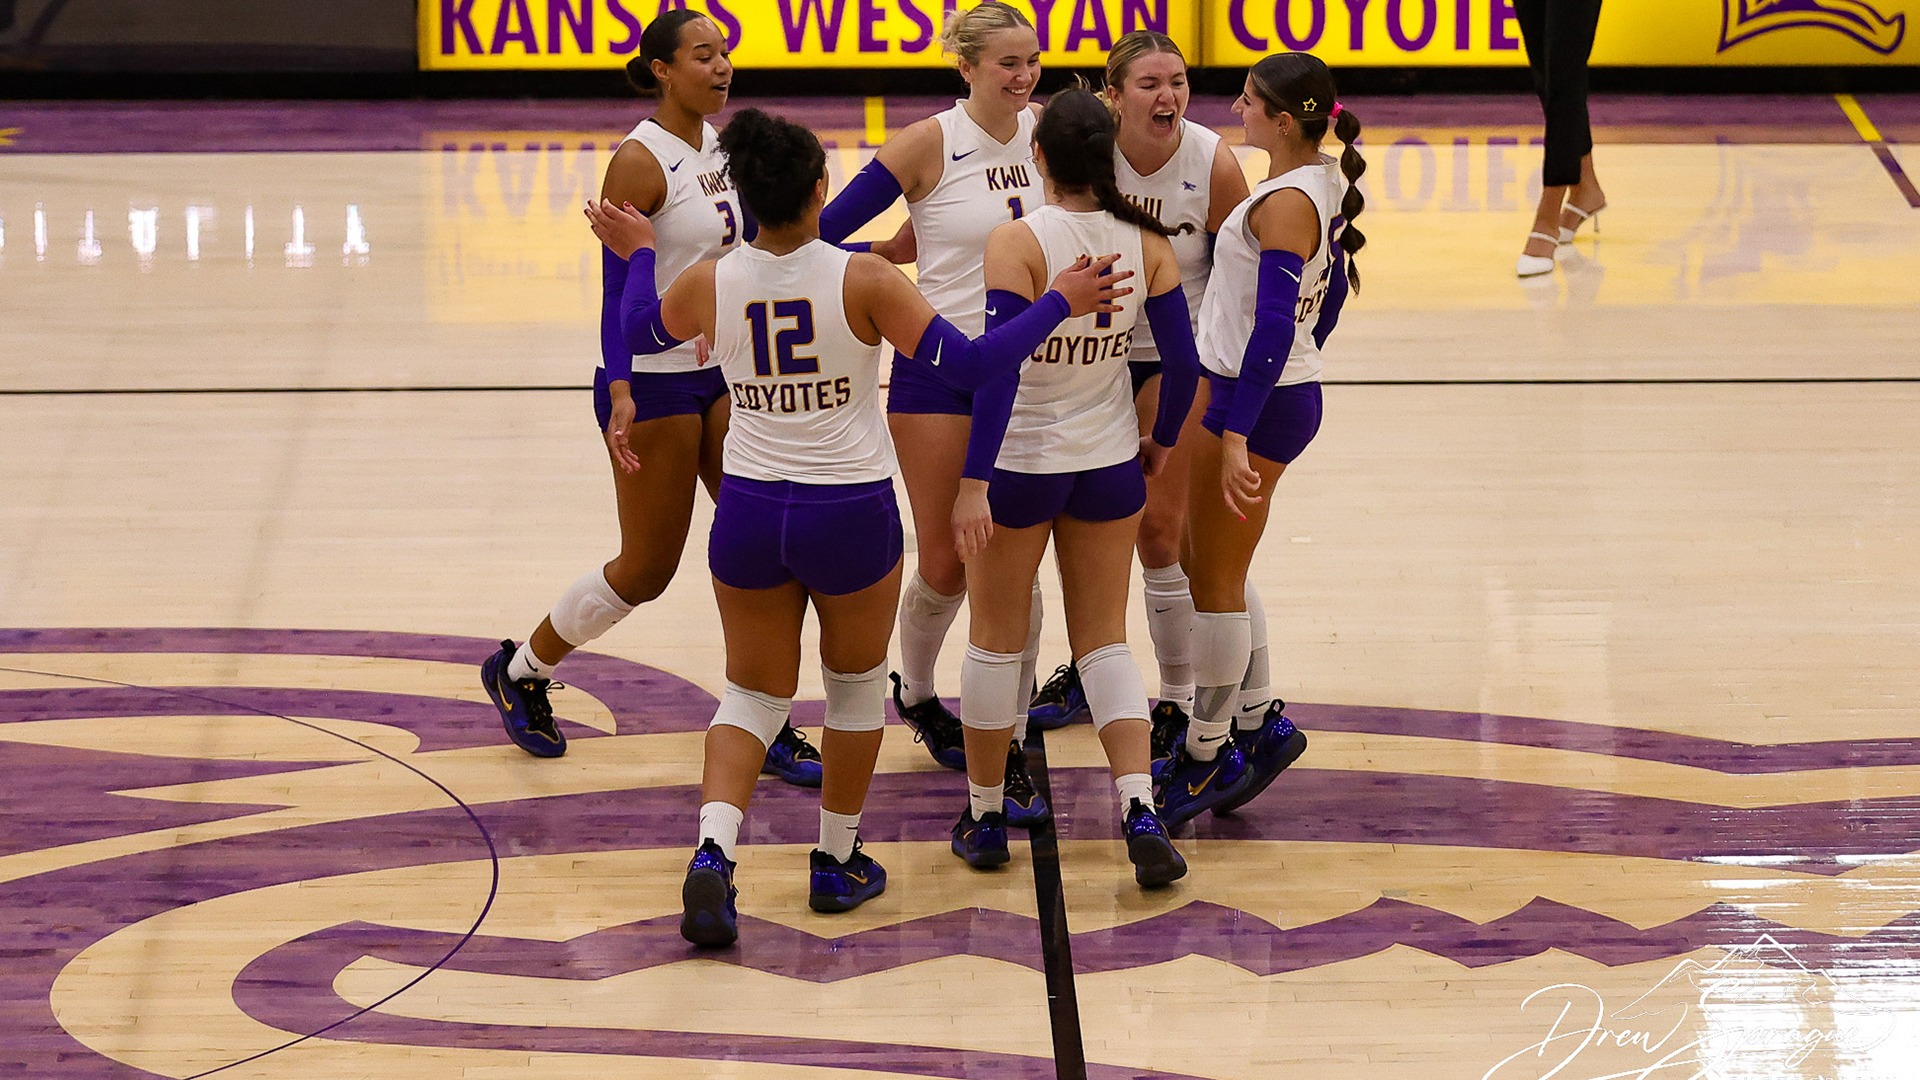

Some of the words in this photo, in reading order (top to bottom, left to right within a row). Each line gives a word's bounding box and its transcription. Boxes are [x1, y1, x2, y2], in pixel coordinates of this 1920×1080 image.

[440, 0, 741, 54] KANSS
[776, 0, 1168, 53] WESYAN
[1229, 0, 1520, 51] COYOTE
[696, 170, 729, 197] KWU
[985, 164, 1031, 191] KWU
[714, 199, 737, 248] 3
[744, 297, 821, 378] 12
[732, 376, 851, 413] COYOTES
